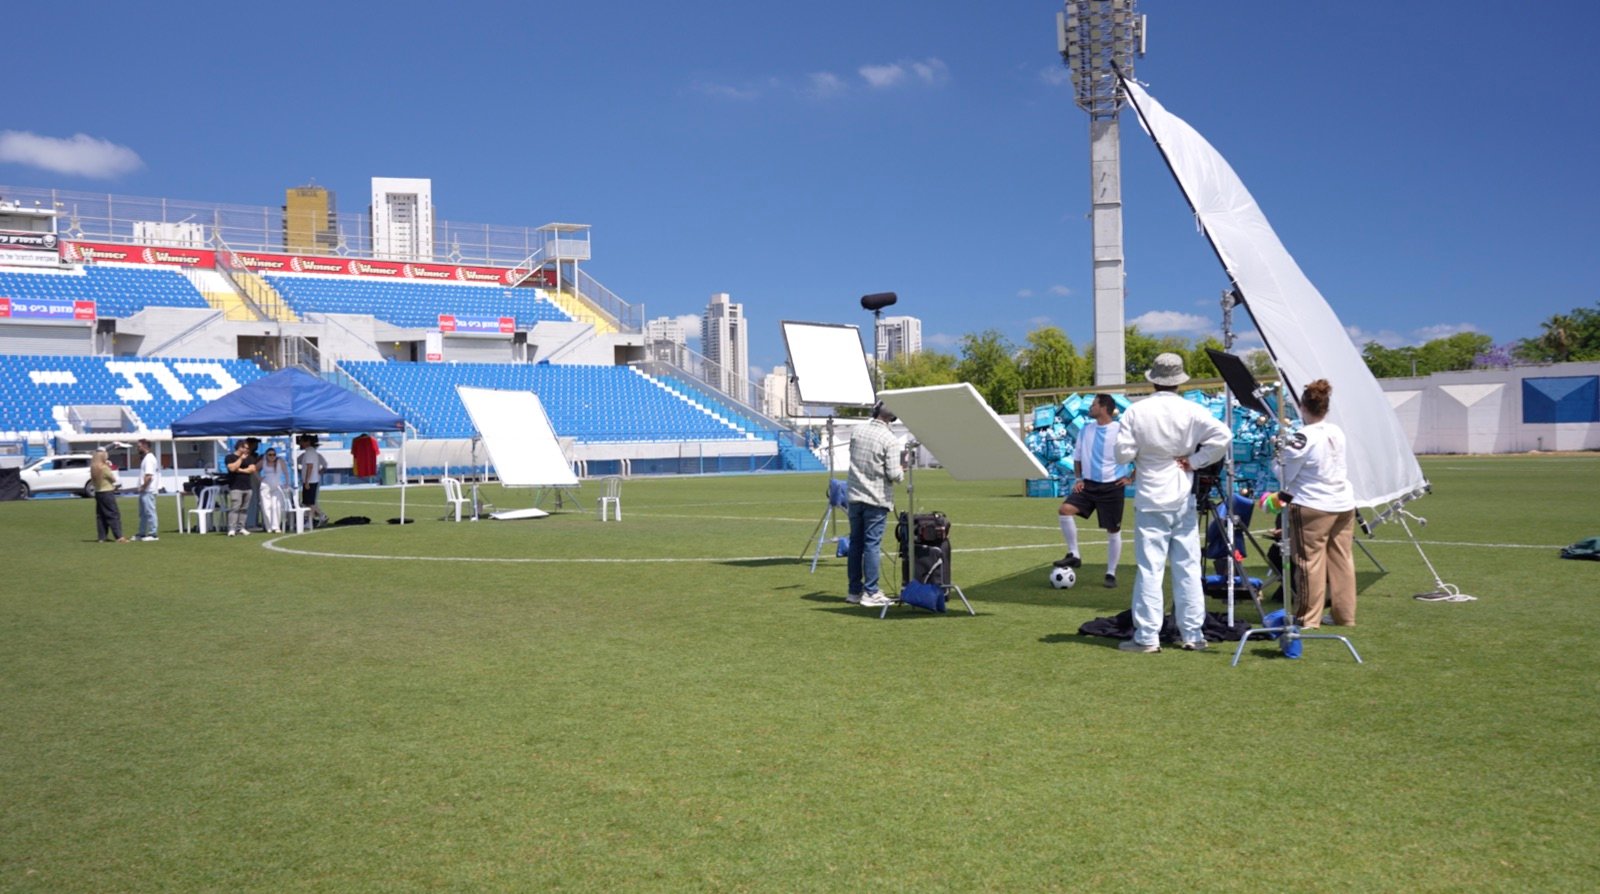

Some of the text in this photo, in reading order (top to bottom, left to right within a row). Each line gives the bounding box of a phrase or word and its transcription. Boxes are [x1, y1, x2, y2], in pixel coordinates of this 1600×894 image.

[80, 247, 201, 263] Winner Winner
[242, 256, 284, 268] Winner
[302, 260, 342, 272] Winner
[360, 263, 398, 274] Winner
[414, 267, 450, 278] Winner
[465, 270, 501, 281] Winner
